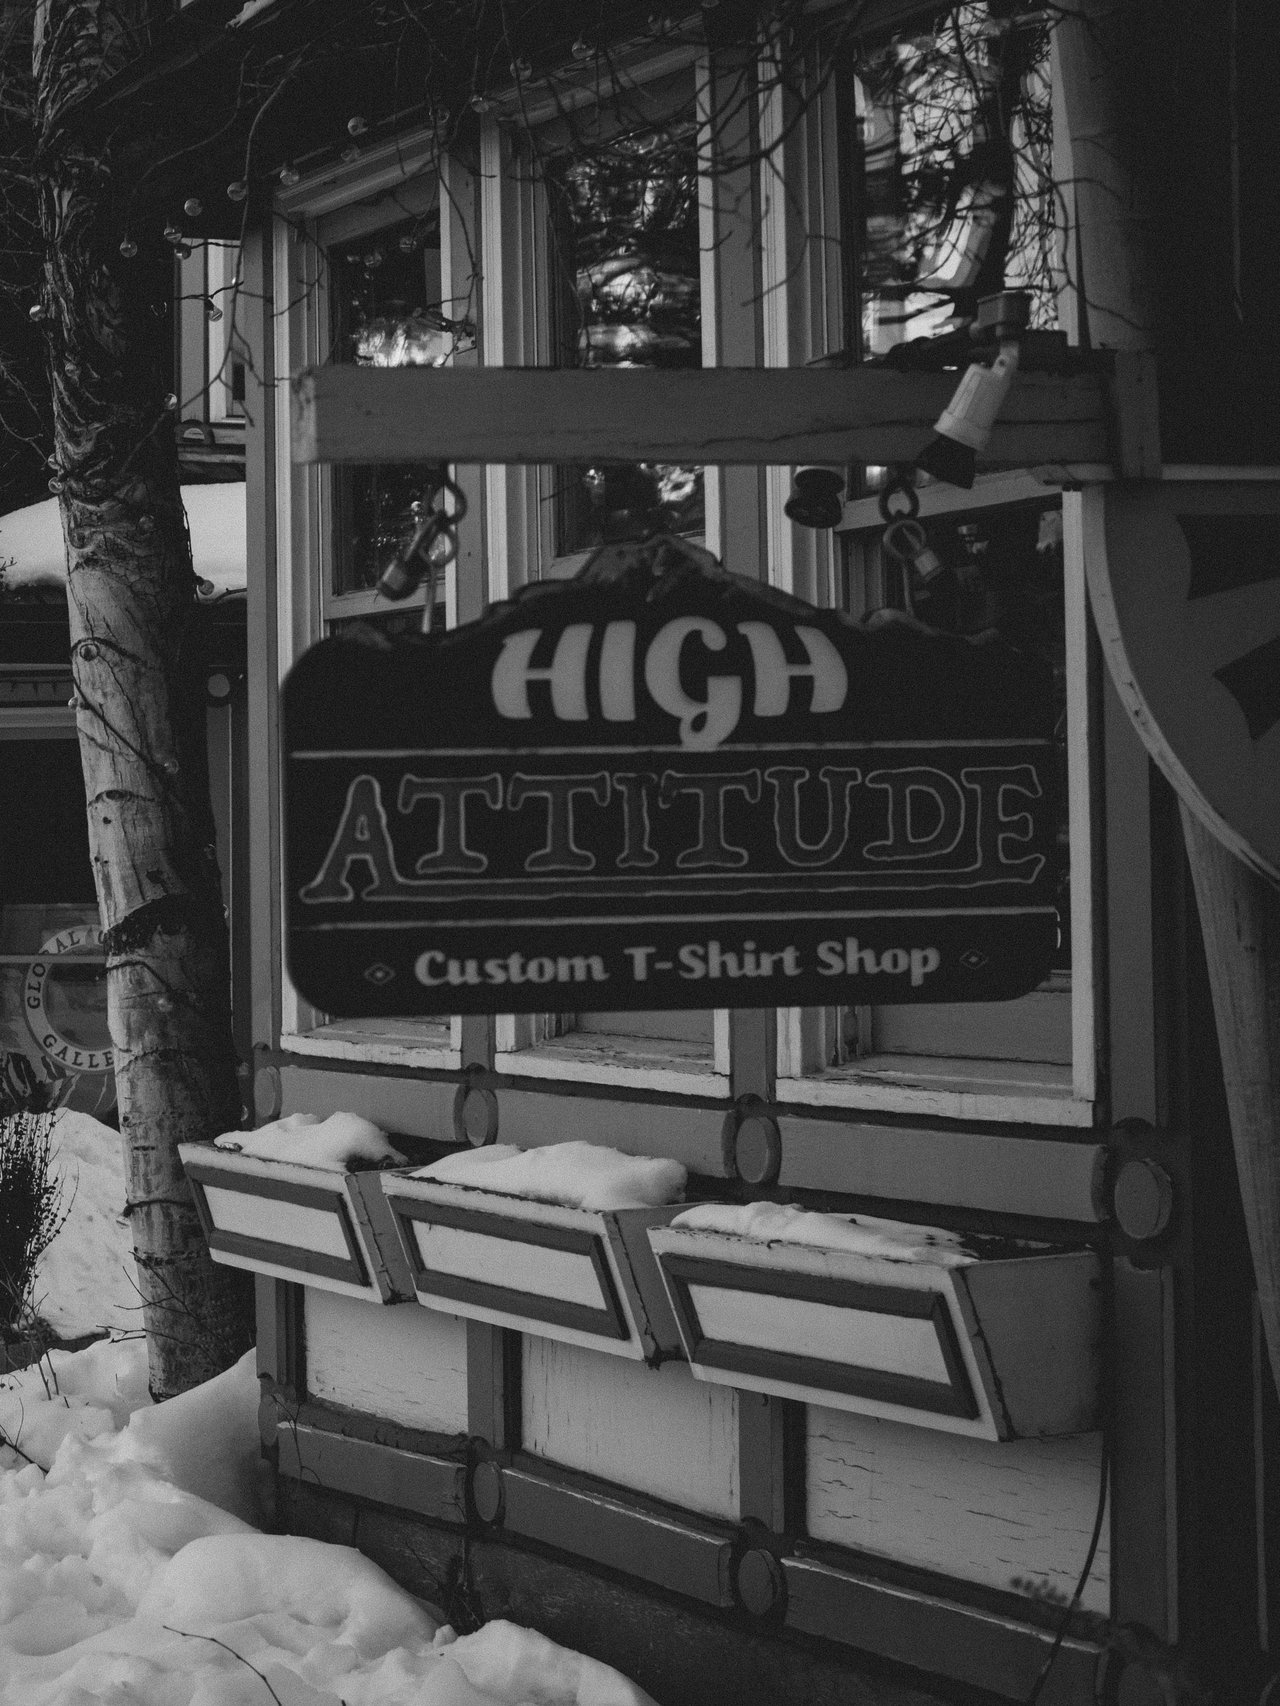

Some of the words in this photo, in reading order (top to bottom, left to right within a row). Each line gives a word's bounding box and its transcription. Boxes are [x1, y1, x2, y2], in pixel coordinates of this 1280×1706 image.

[490, 615, 849, 751] HIGH
[299, 764, 1046, 904] ATTITUDE
[26, 931, 81, 1010] GLOAL
[415, 948, 609, 986] Custom
[625, 938, 803, 982] T-Shirt
[816, 936, 941, 985] Shop
[42, 1033, 114, 1068] GALLE
